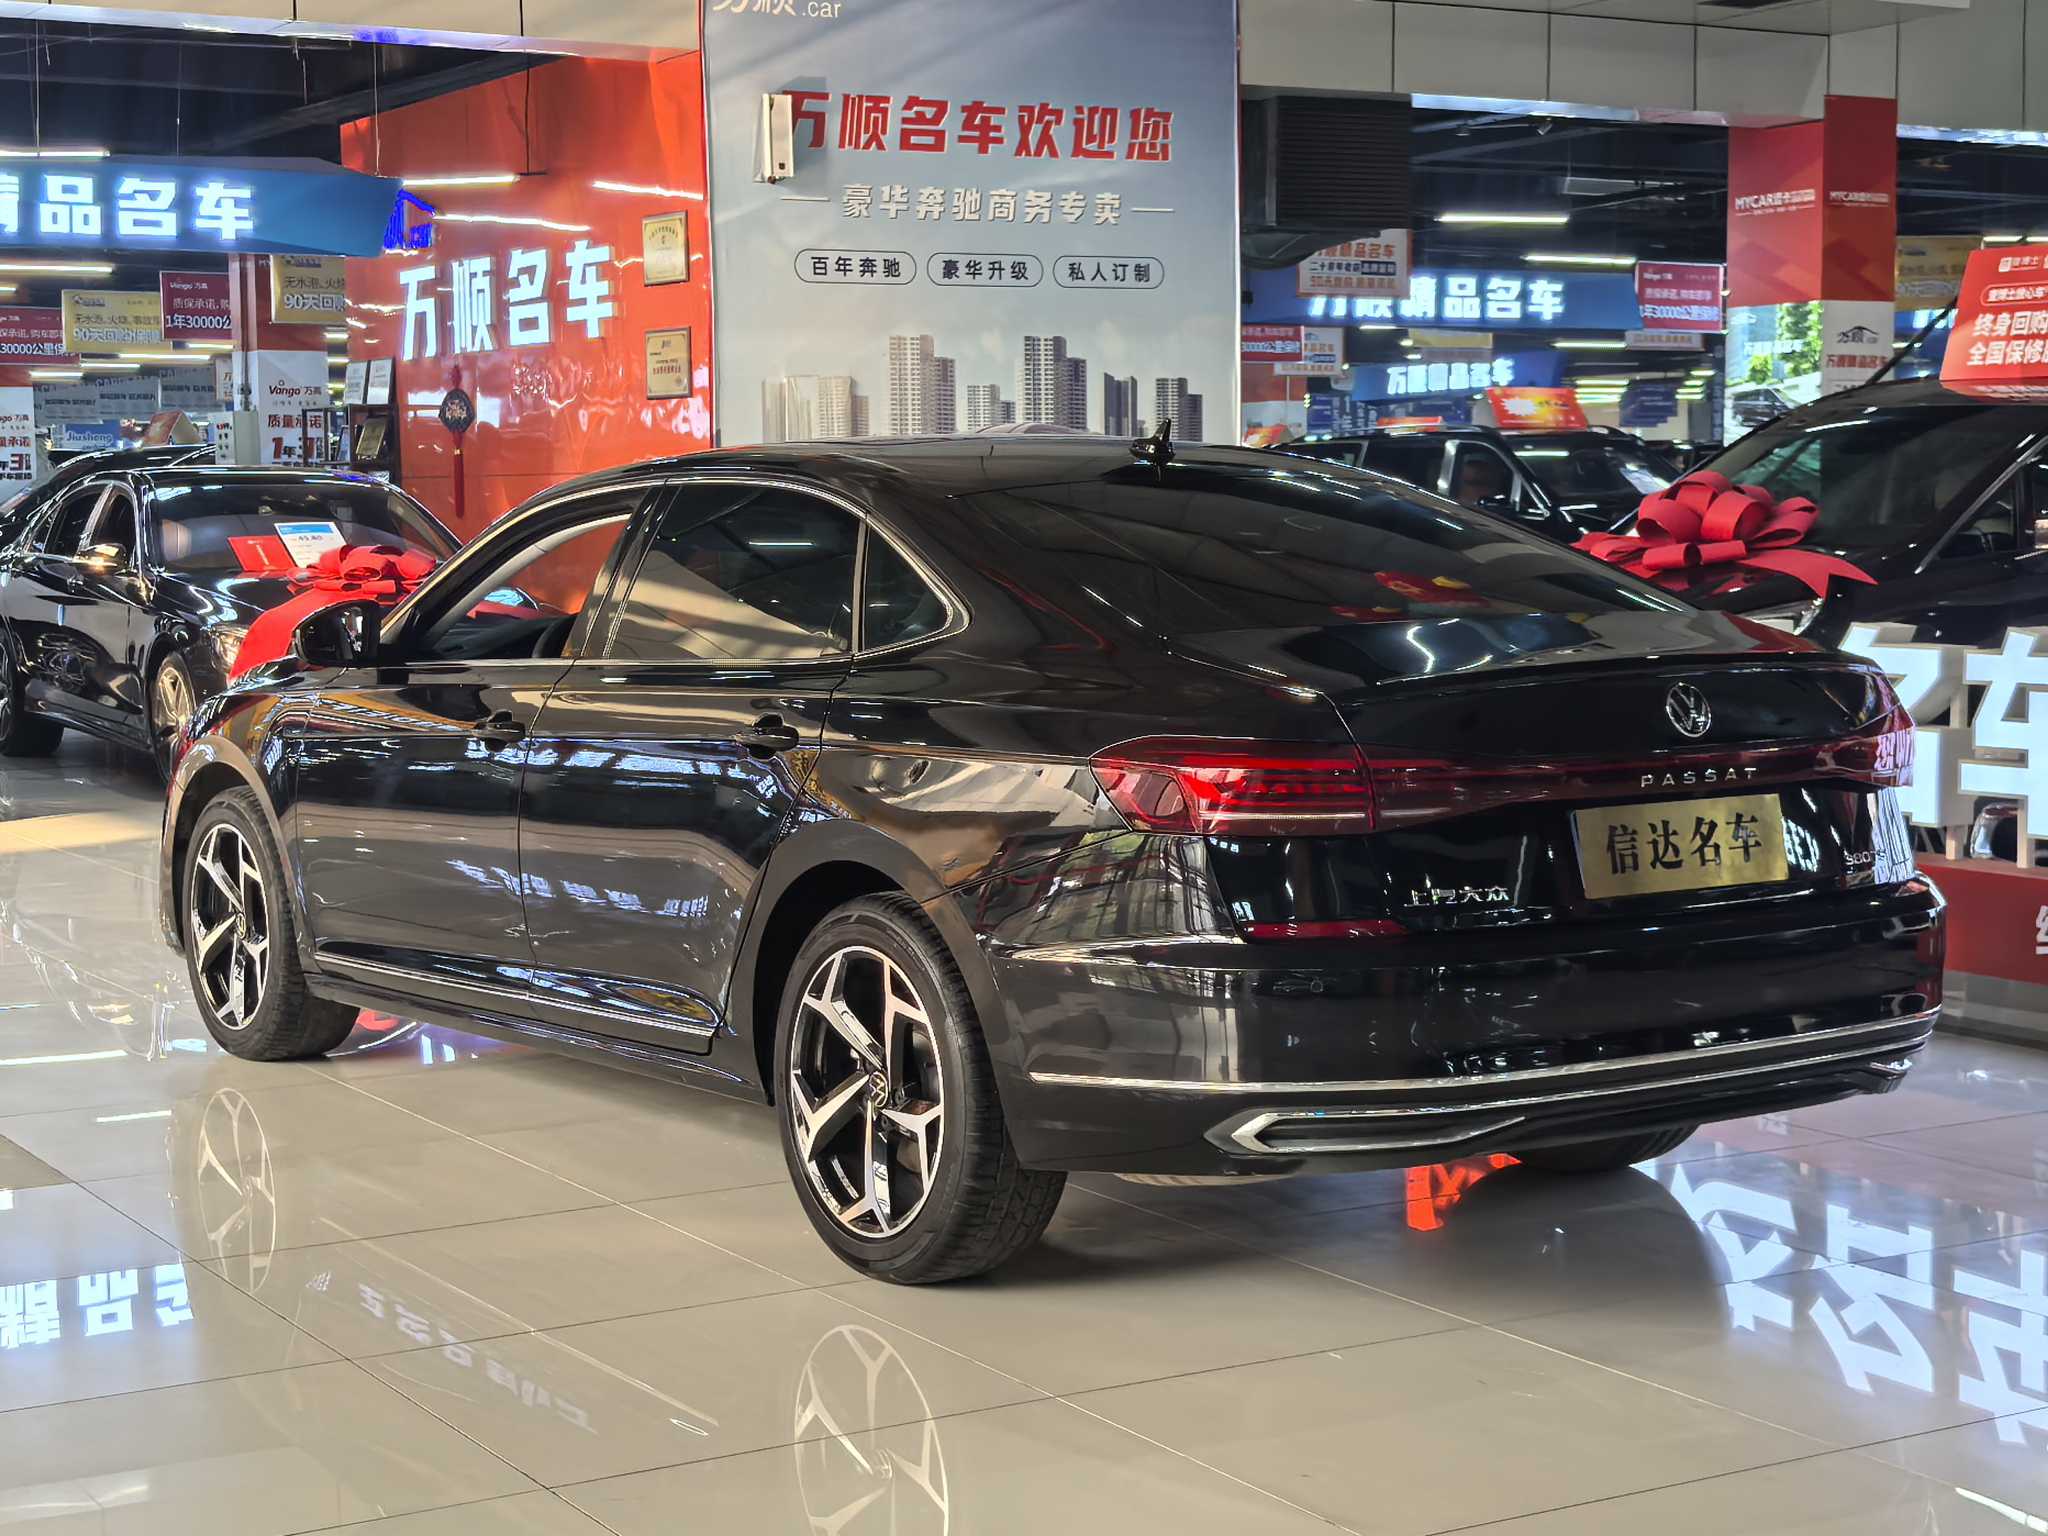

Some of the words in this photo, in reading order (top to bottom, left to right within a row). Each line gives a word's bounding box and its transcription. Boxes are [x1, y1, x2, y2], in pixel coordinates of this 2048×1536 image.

[782, 90, 1175, 163] 万顺名车欢迎您
[841, 184, 1123, 226] 豪华奔驰商务专卖
[810, 256, 902, 279] 百年奔驰
[942, 258, 1030, 282] 豪华升级
[1068, 261, 1152, 284] 私人订制
[399, 240, 615, 362] 万顺名车
[268, 385, 301, 398] Vango
[1640, 766, 1758, 788] PASSAT
[1605, 811, 1764, 876] 信达名车
